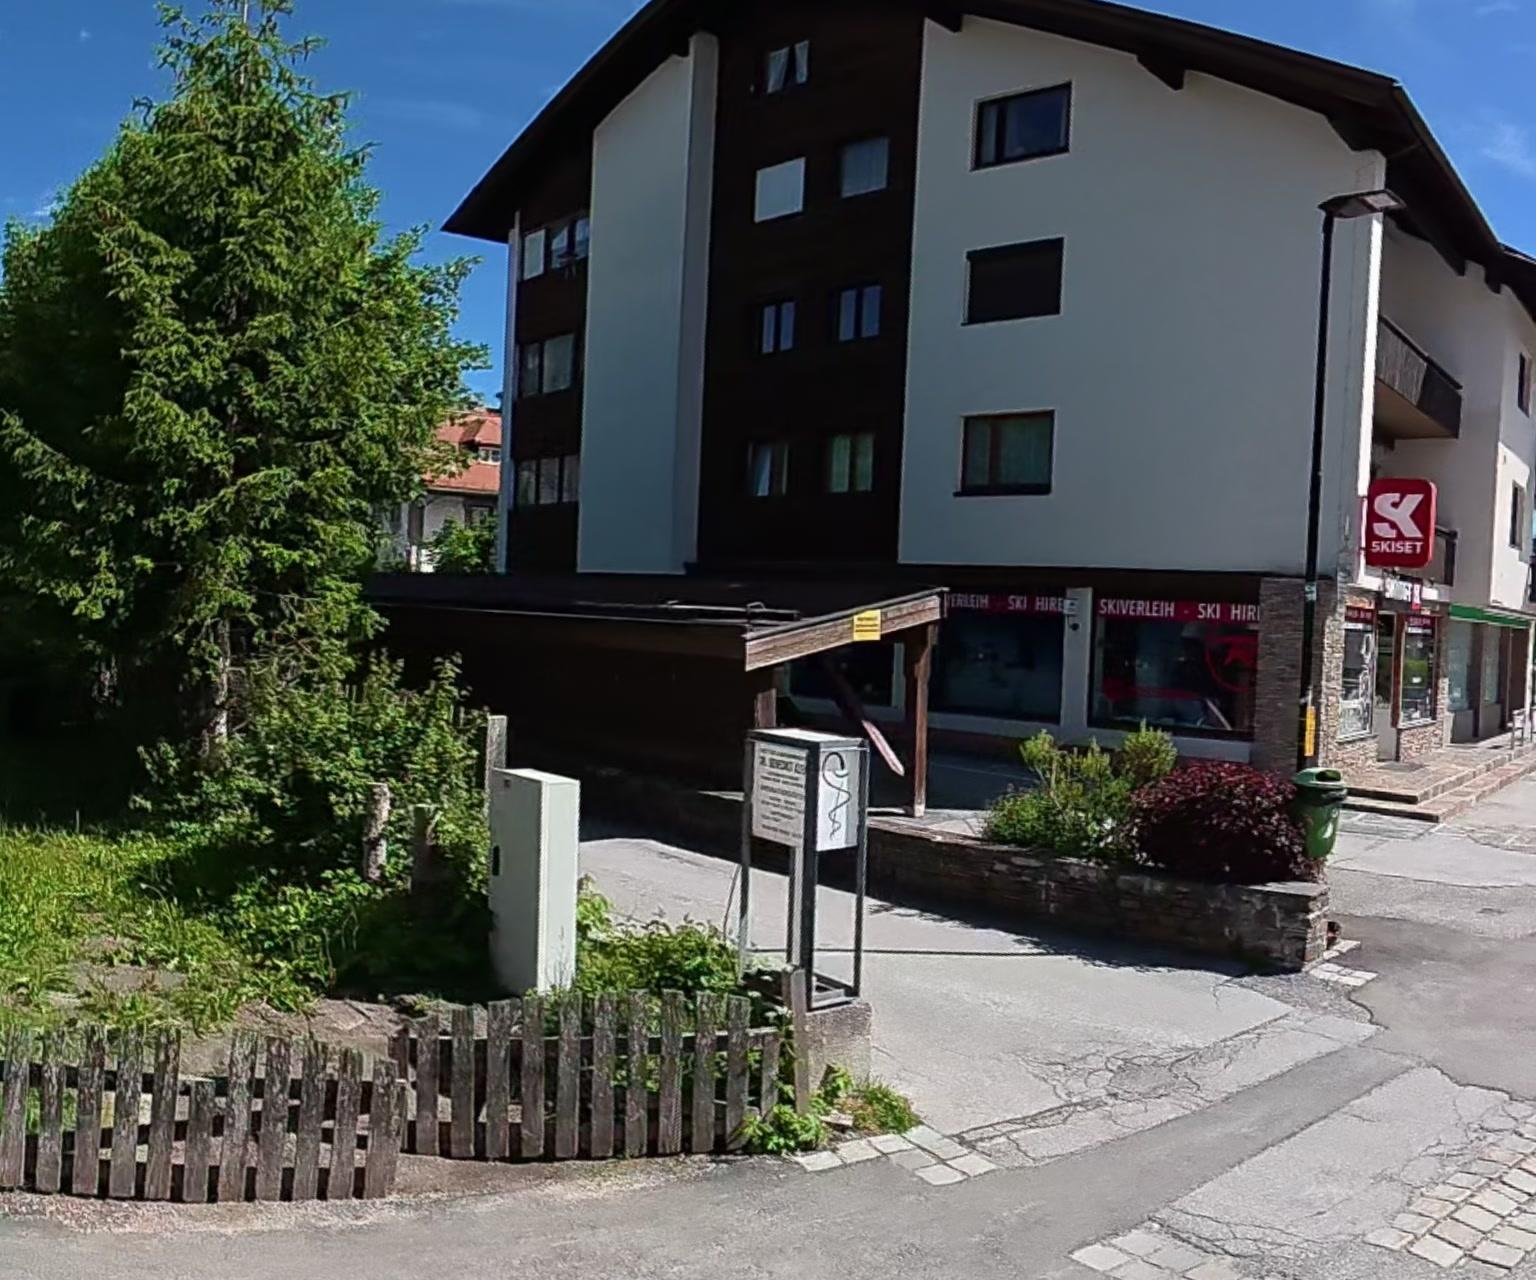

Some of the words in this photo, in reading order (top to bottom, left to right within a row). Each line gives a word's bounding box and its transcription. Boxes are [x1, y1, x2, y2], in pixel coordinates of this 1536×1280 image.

[1370, 540, 1424, 555] SKISET
[1007, 594, 1028, 610] SKI
[1035, 597, 1064, 612] HIRE
[1098, 598, 1175, 618] SKIVERLEIH
[1197, 603, 1221, 619] SKI
